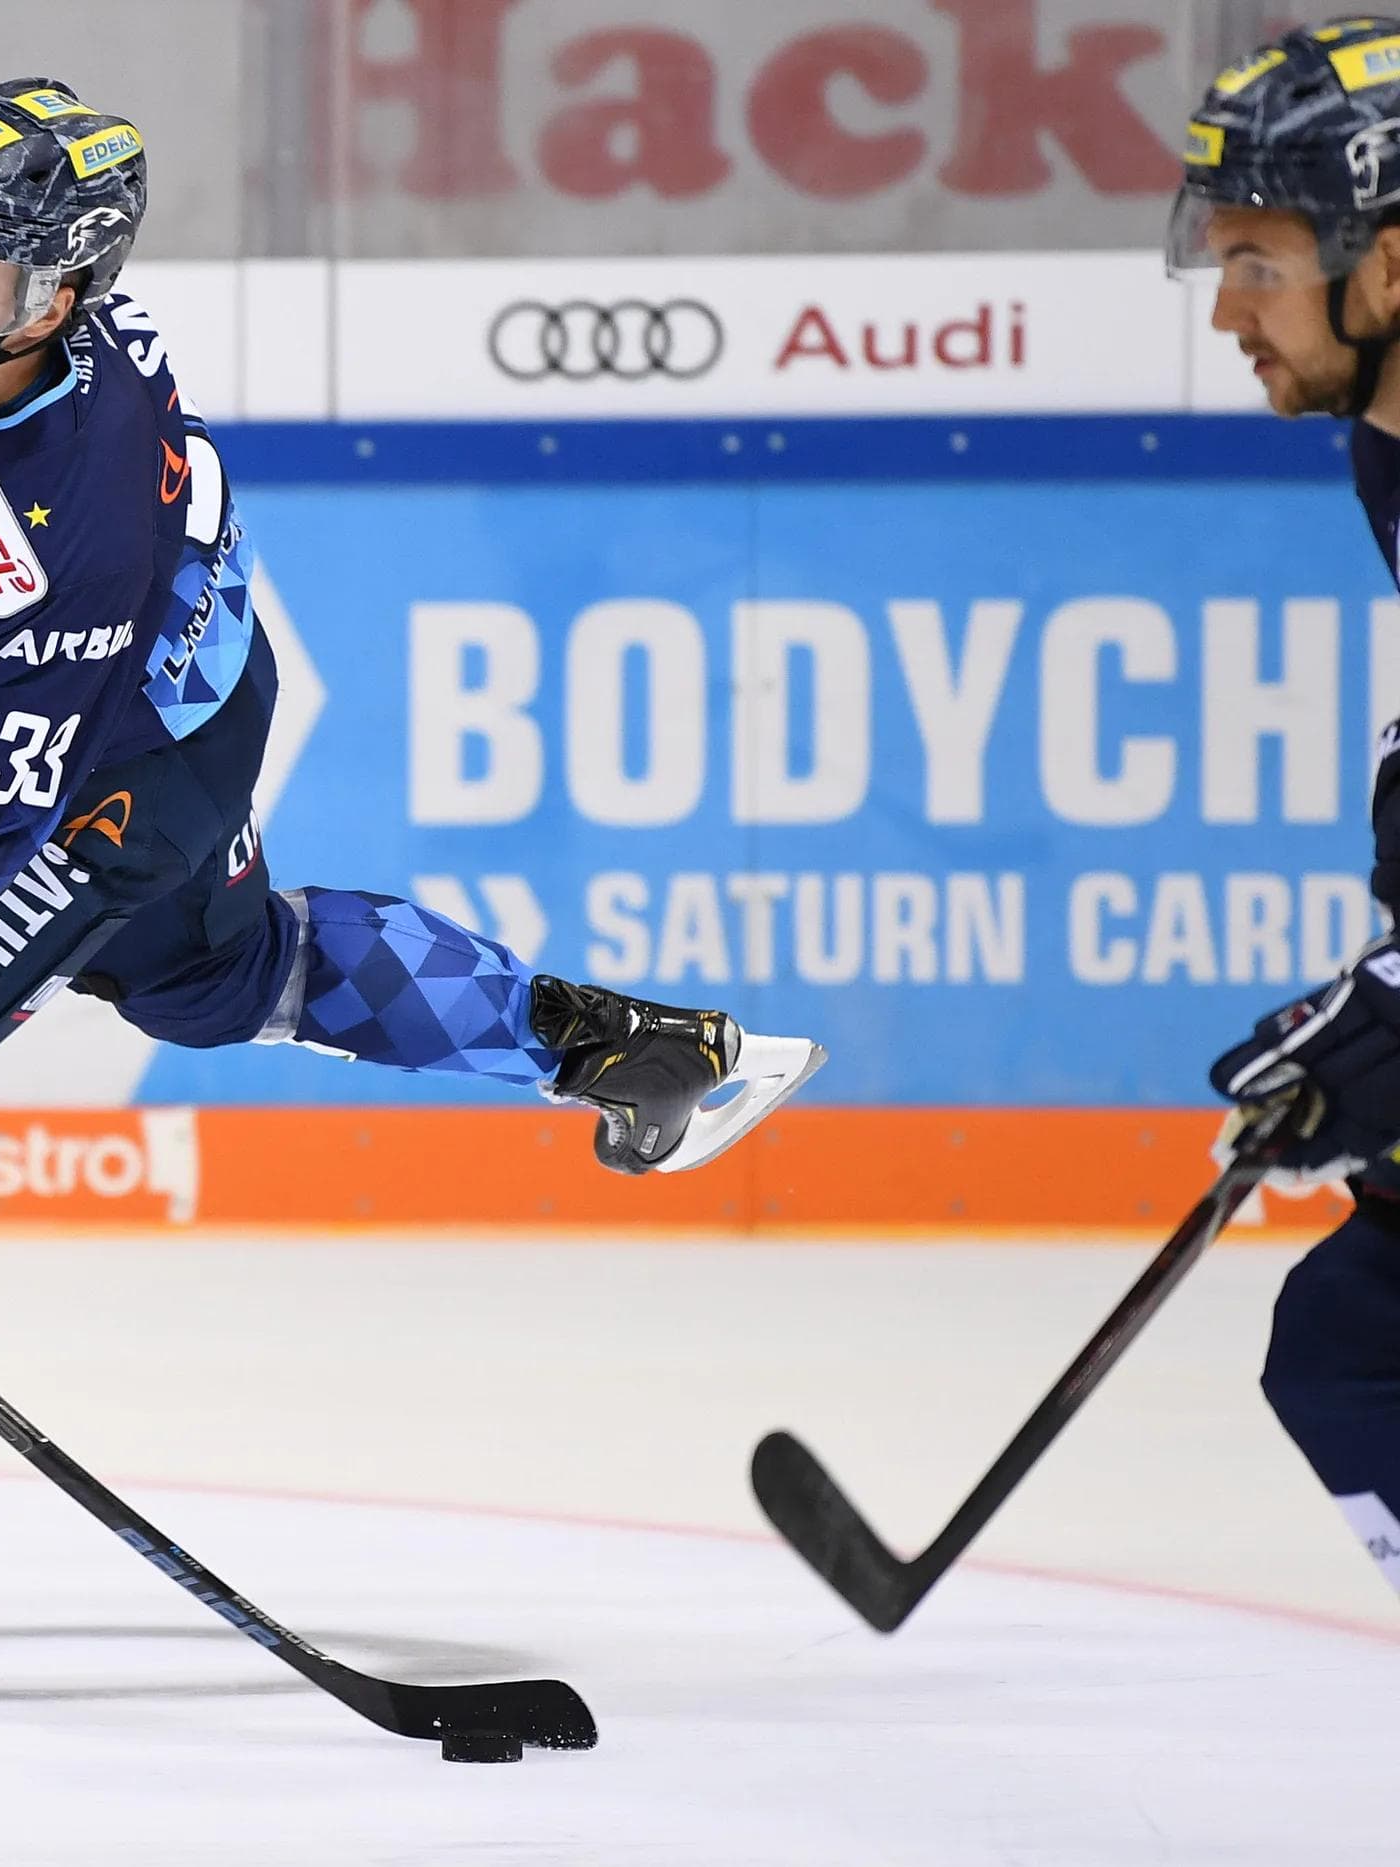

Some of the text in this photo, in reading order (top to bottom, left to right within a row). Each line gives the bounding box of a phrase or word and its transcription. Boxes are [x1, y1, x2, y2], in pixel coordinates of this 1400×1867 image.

[81, 131, 138, 165] EDEKA
[775, 304, 1028, 370] Audi
[408, 598, 1388, 826] BODYCH
[587, 874, 1393, 984] SATURN CARD
